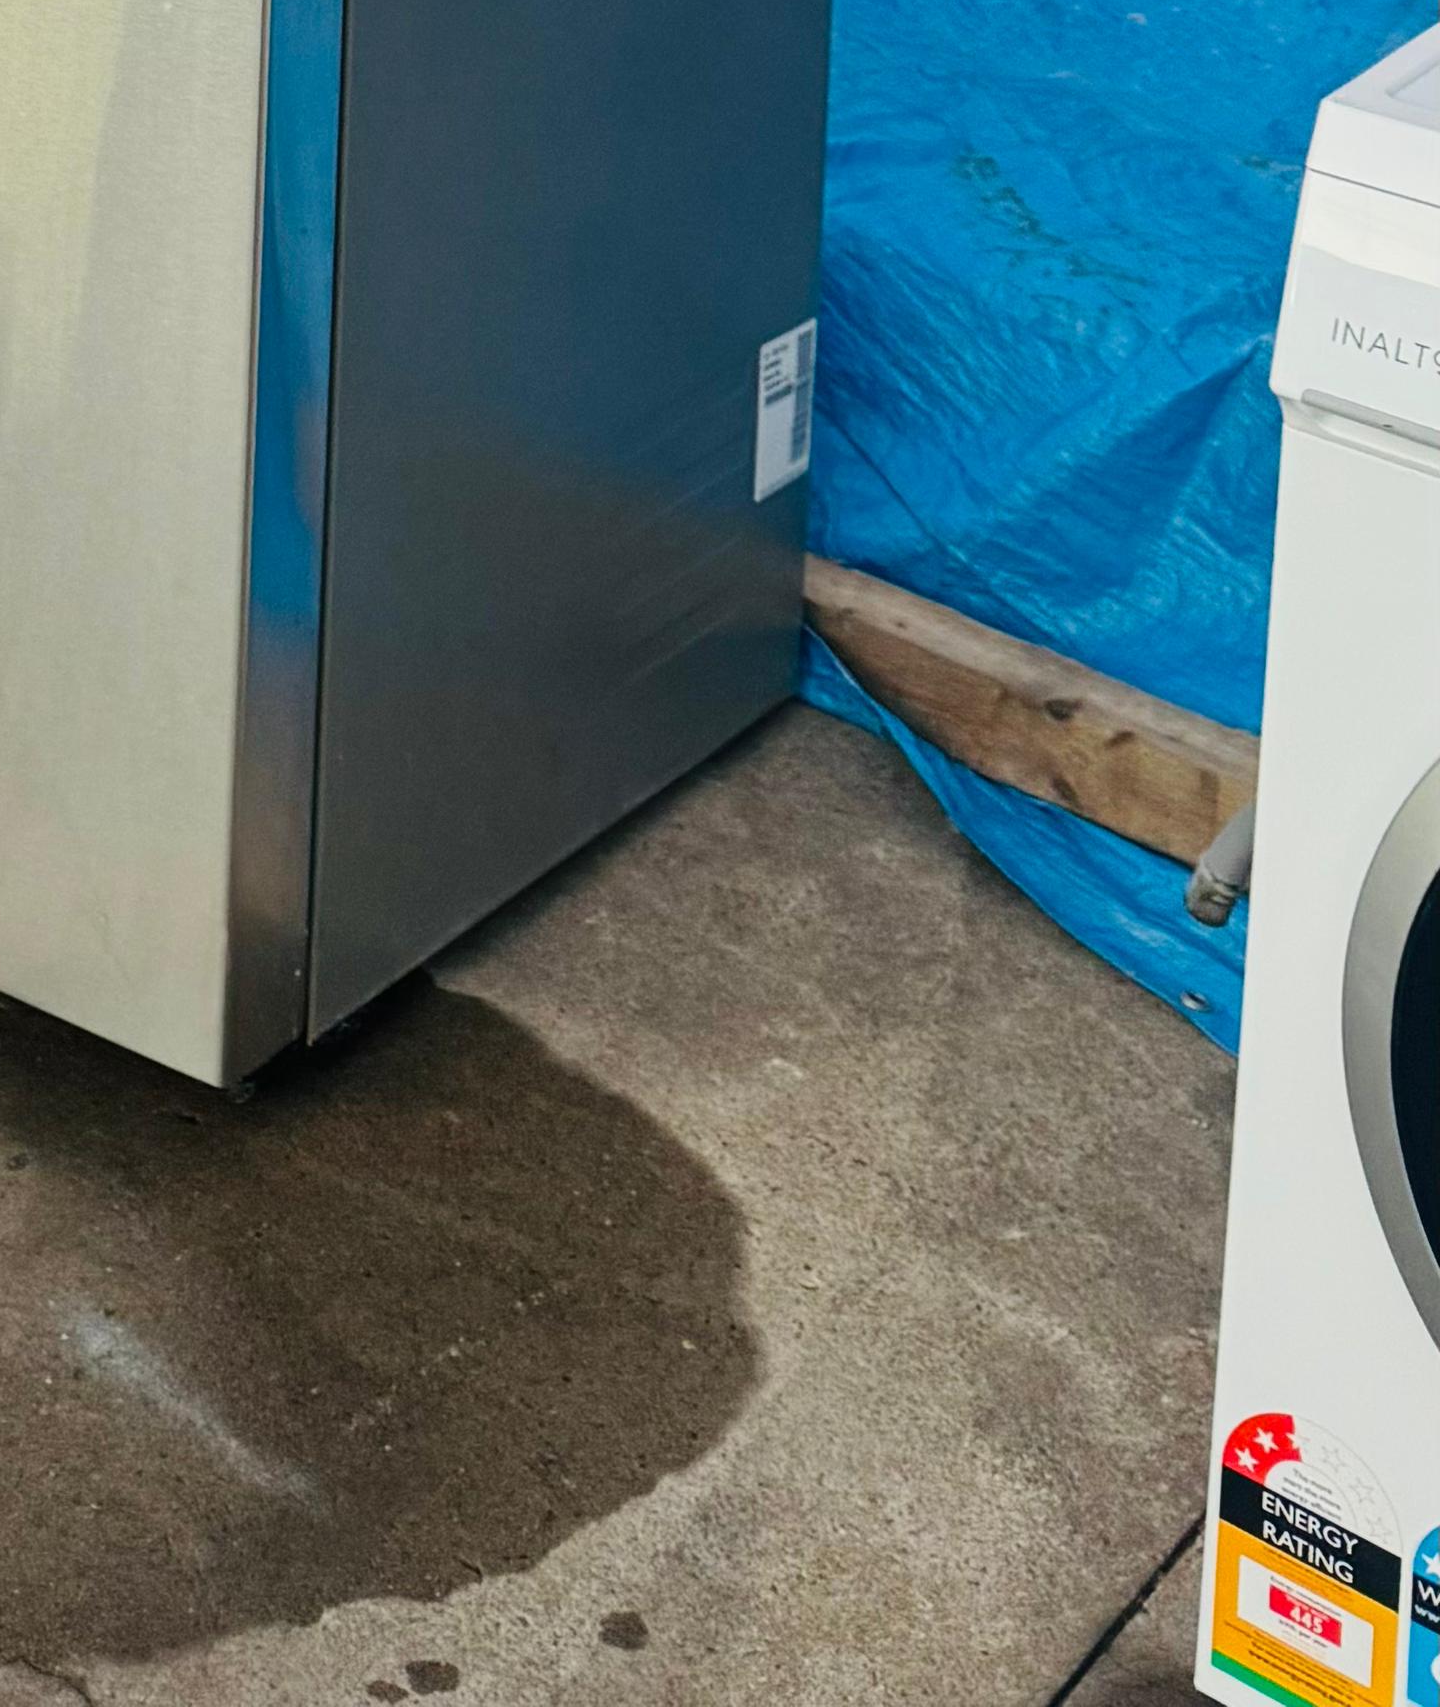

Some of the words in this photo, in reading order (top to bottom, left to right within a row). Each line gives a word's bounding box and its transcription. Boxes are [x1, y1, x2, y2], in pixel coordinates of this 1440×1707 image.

[1262, 1490, 1359, 1556] ENERGY
[1263, 1519, 1354, 1585] RATING
[1289, 1604, 1324, 1635] 445
